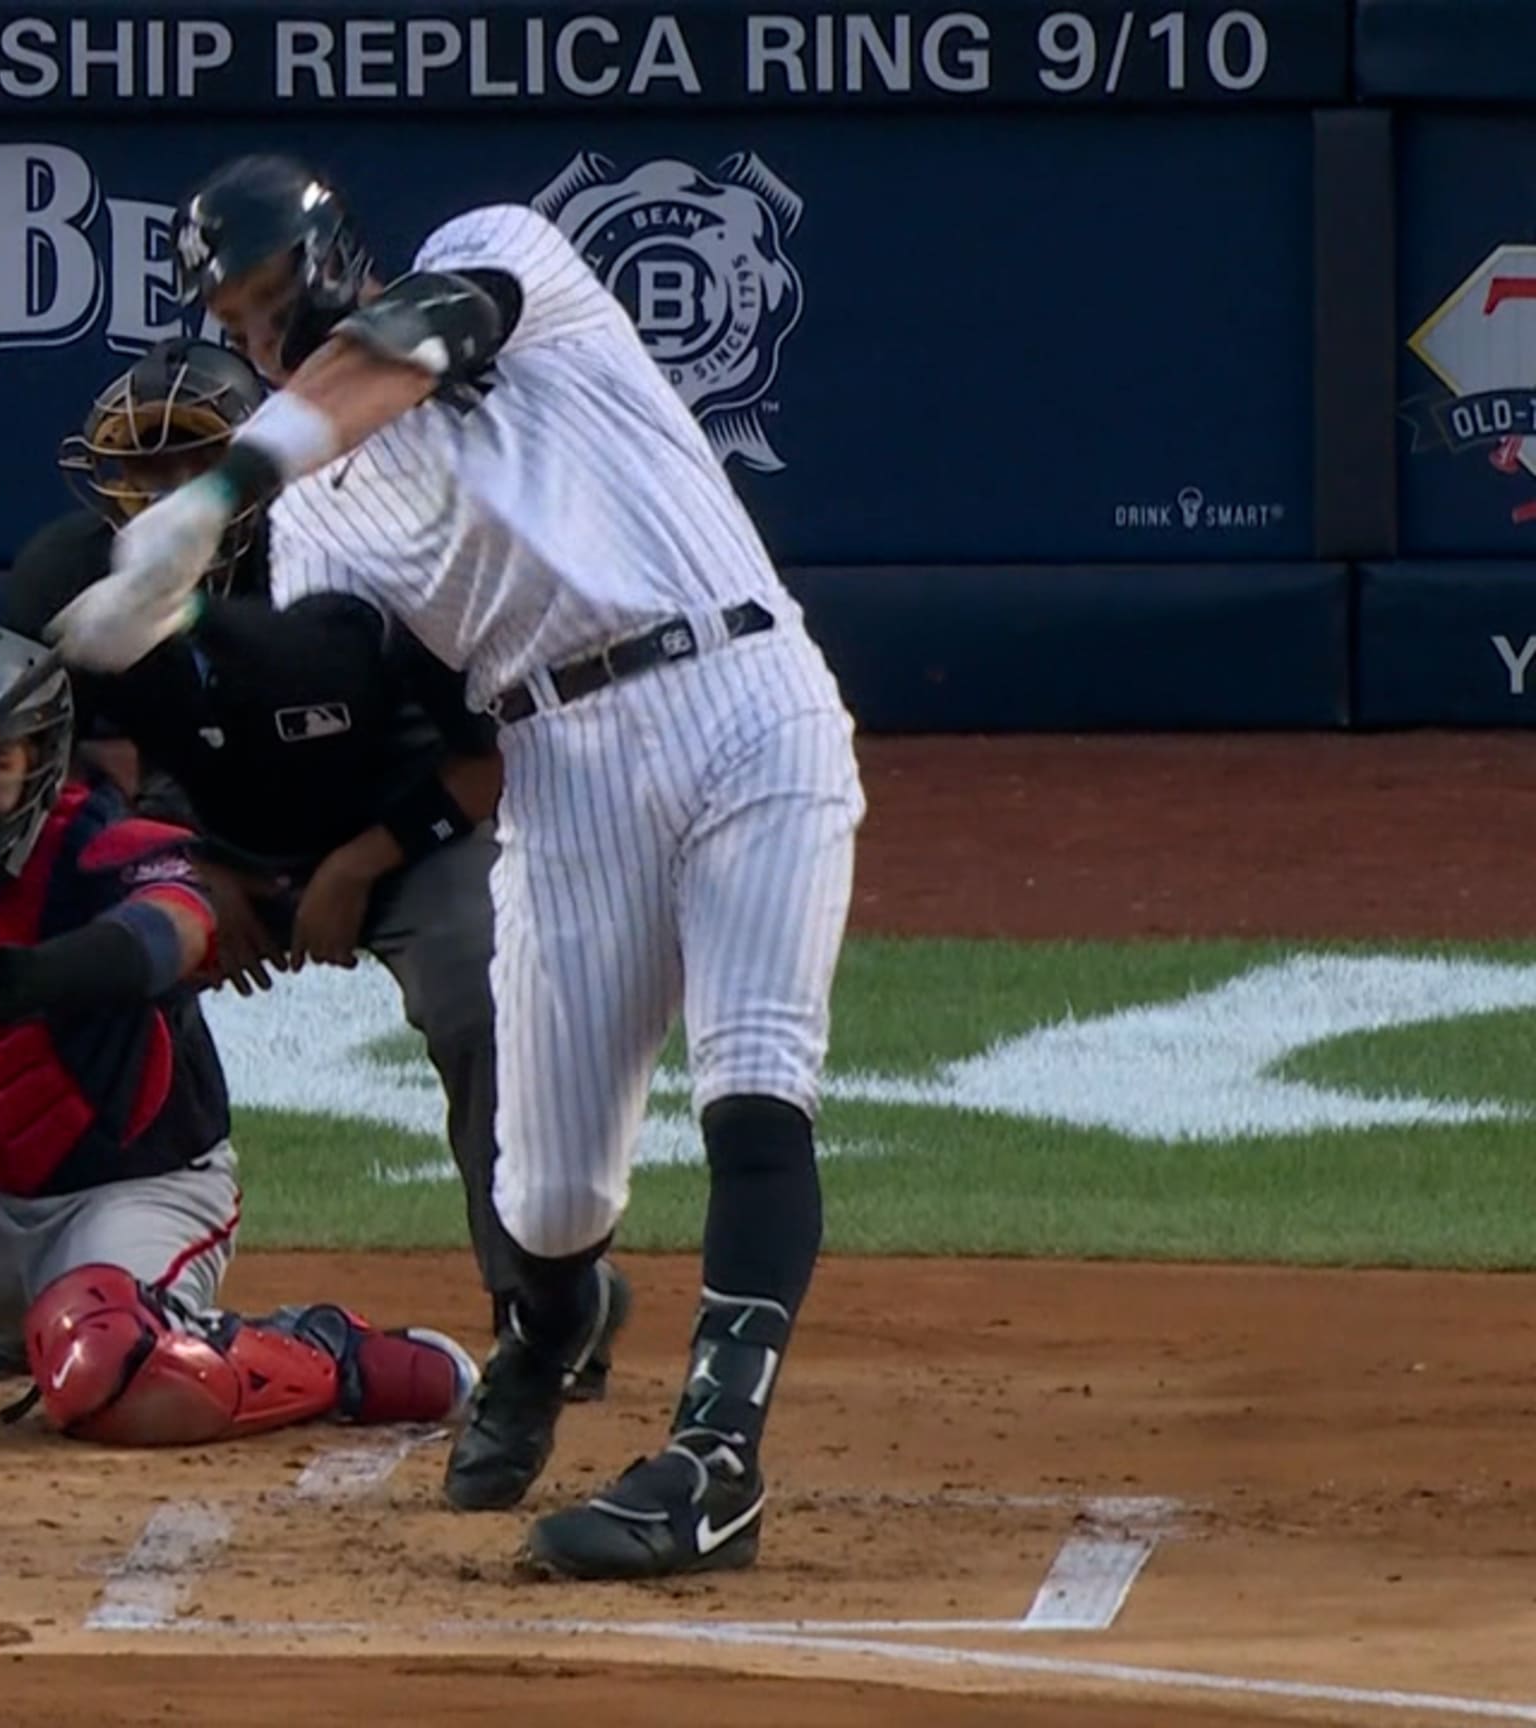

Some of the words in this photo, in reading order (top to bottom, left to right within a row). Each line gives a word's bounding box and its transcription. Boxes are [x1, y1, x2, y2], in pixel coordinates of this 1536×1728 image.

[276, 16, 702, 97] REPLICA
[747, 13, 991, 93] RING
[1037, 11, 1268, 93] 9/10
[631, 206, 703, 230] BEAM
[636, 260, 696, 331] B
[693, 324, 752, 382] SINCE
[732, 254, 756, 309] 1795
[1115, 505, 1172, 527] DRINK
